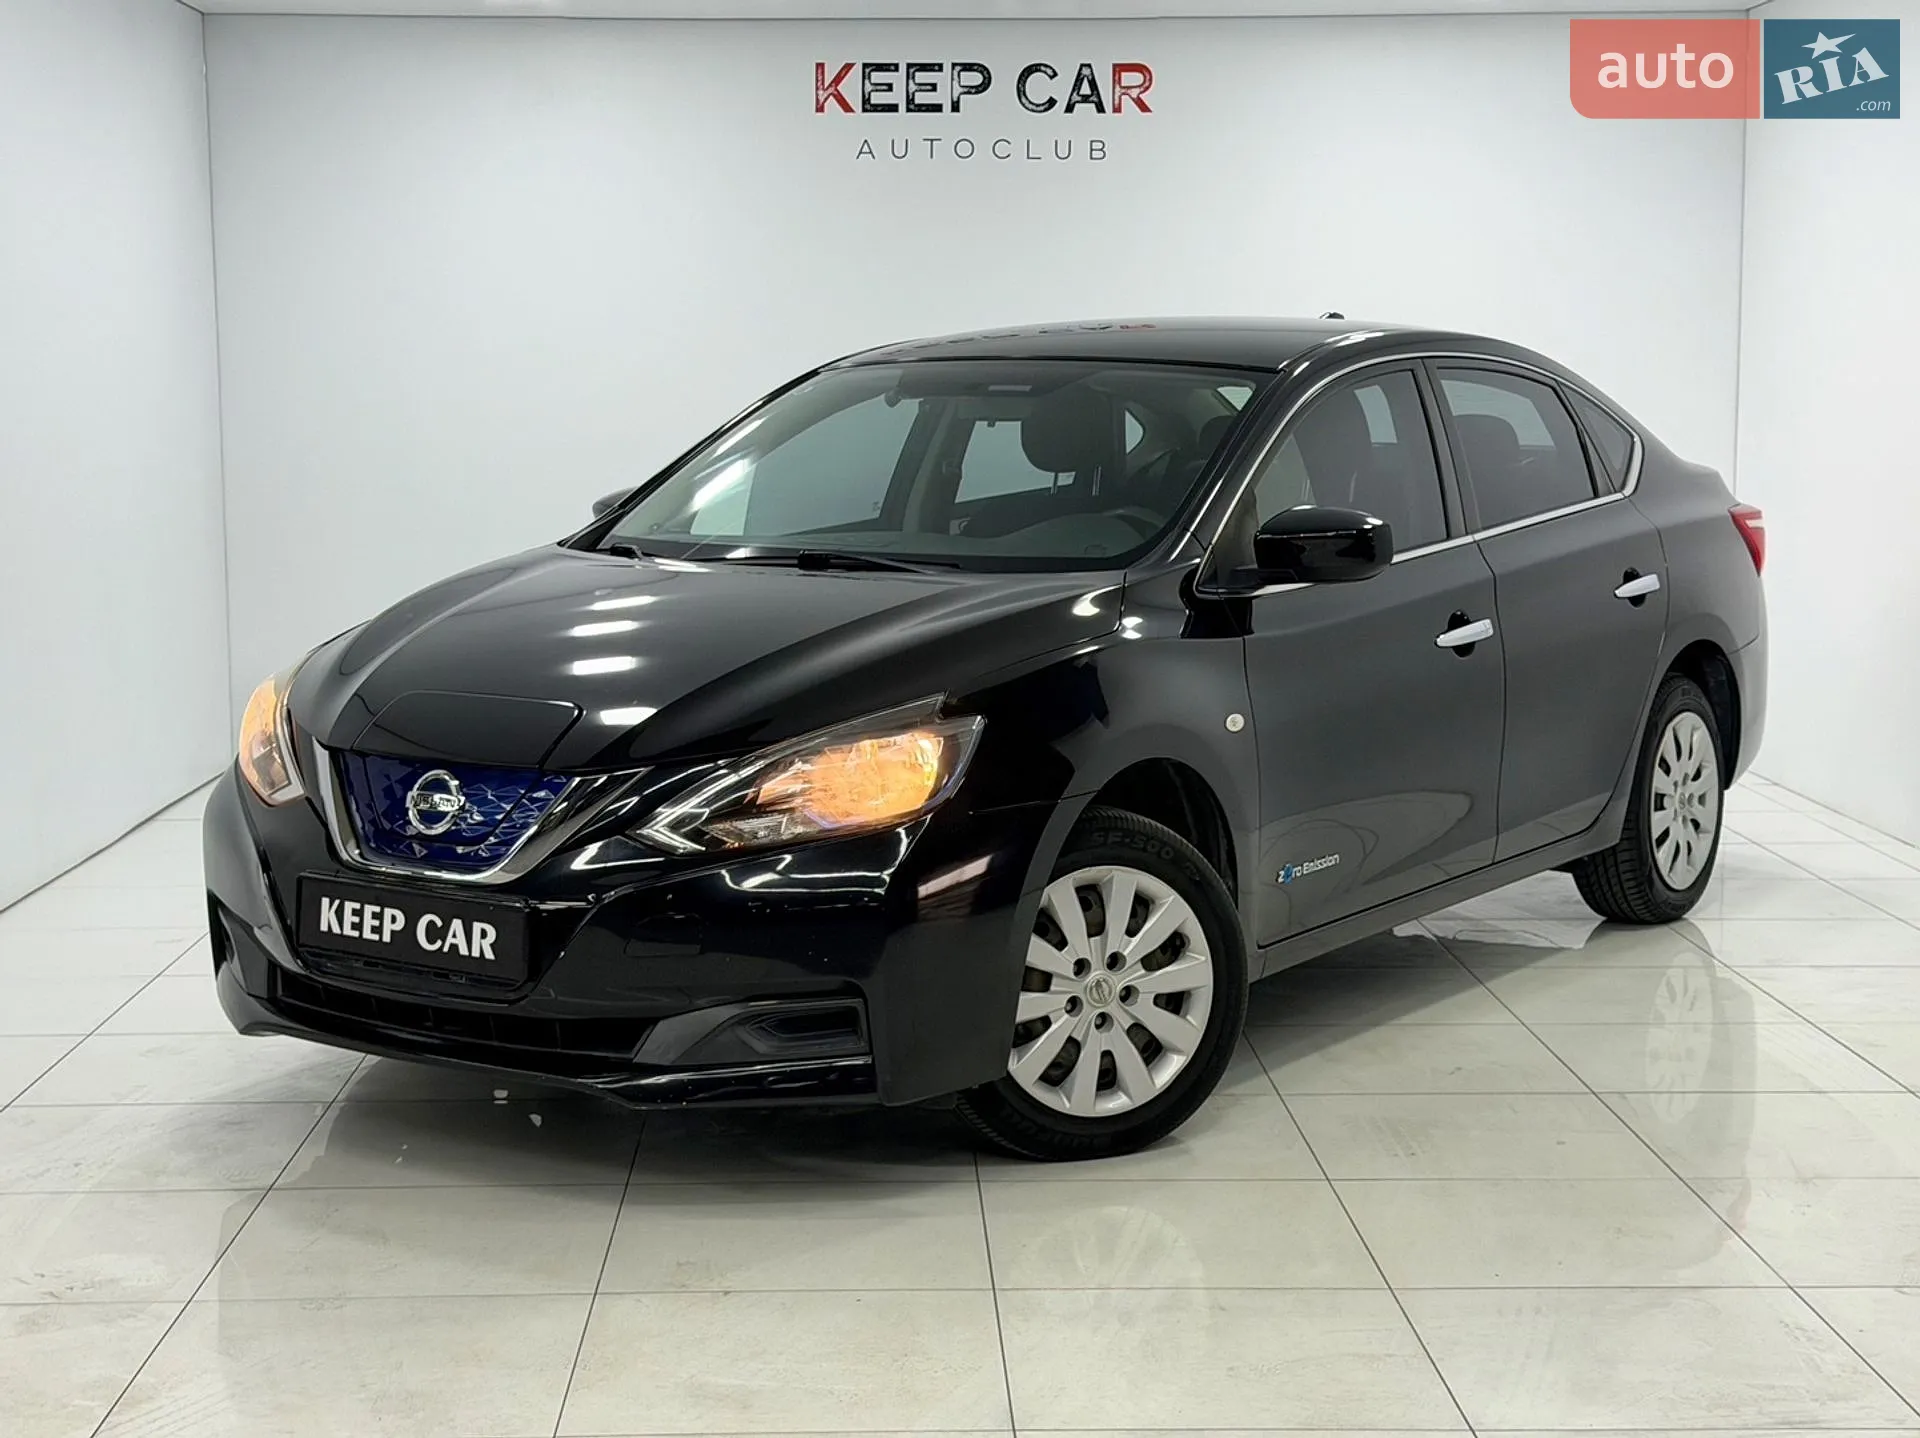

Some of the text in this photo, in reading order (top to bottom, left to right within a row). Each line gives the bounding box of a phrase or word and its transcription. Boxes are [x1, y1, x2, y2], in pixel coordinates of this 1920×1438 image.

[813, 61, 1154, 114] KEEP CAR
[855, 137, 1108, 161] AUTOCLUB
[319, 896, 498, 961] KEEP CAR
